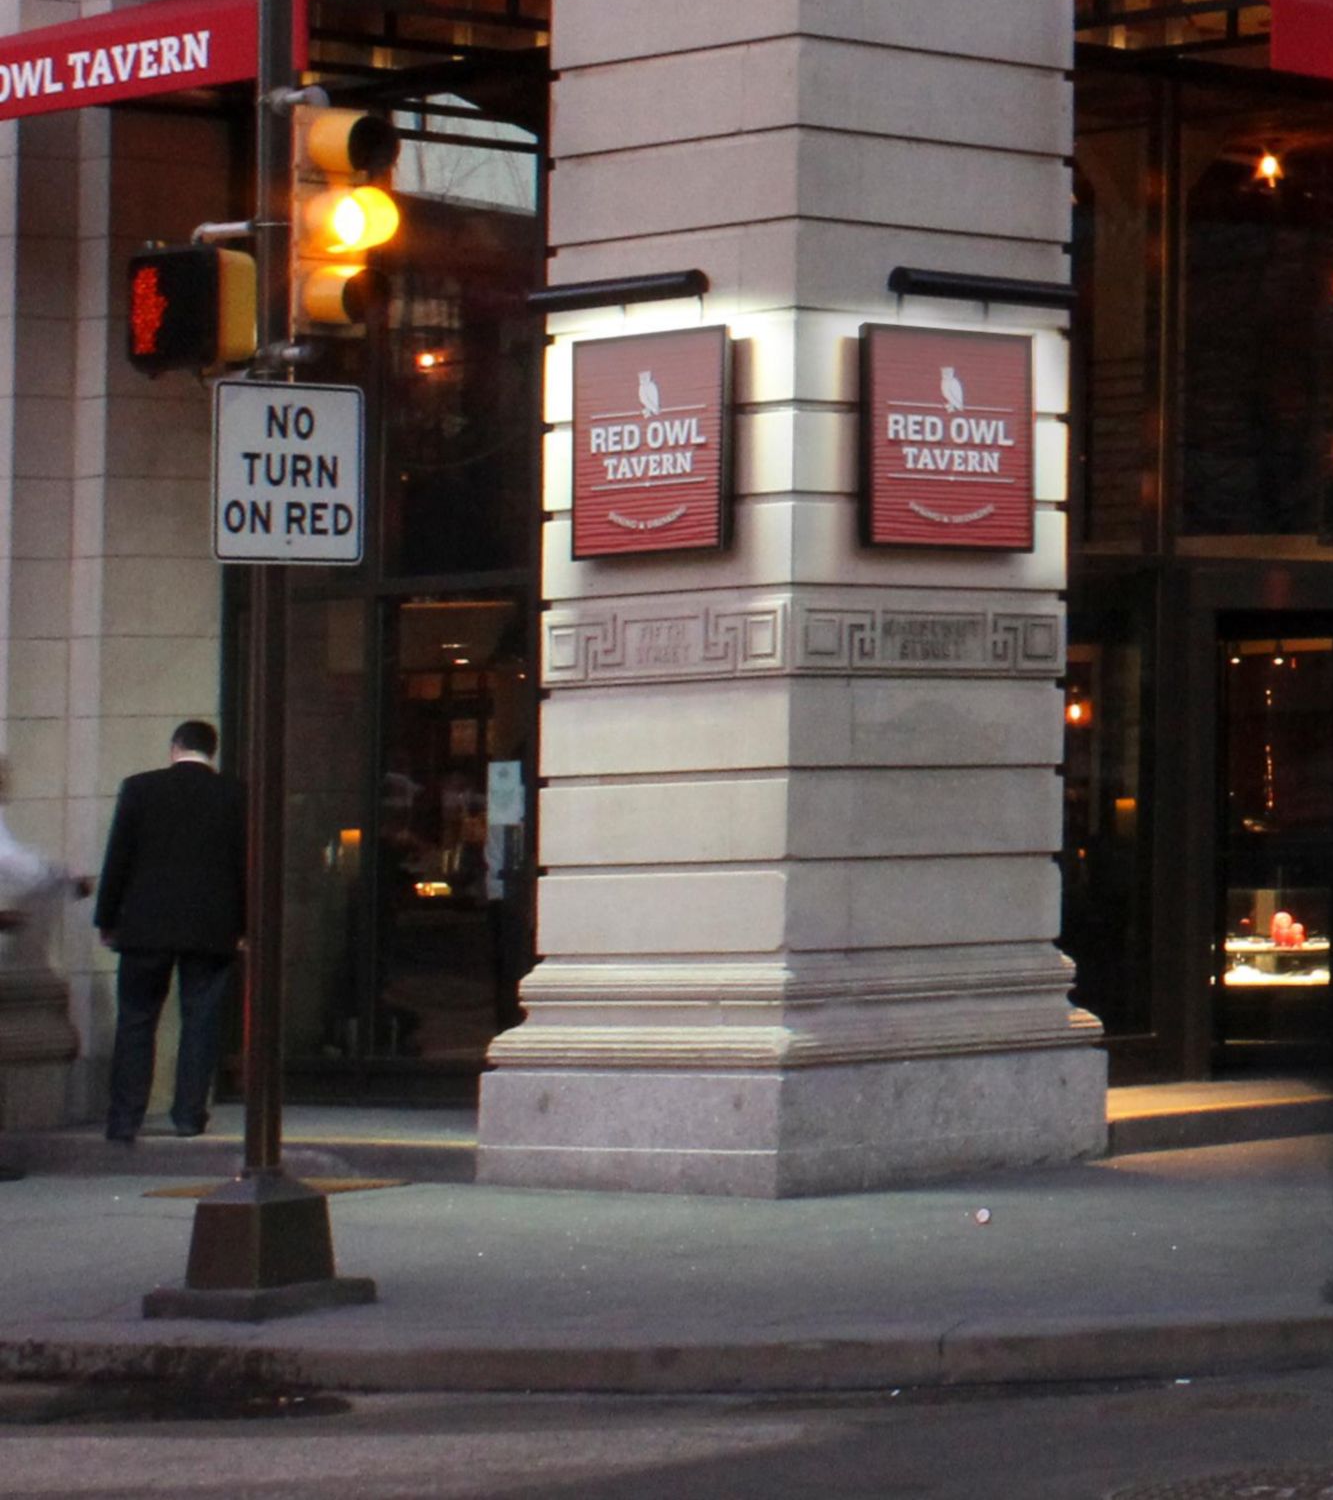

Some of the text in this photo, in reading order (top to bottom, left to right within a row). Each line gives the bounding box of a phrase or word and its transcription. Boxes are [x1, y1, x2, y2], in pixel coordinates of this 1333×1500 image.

[67, 30, 210, 90] TAVERN
[266, 405, 315, 440] NO
[590, 417, 707, 454] RED OWL
[888, 413, 1016, 446] RED OWL
[242, 452, 339, 488] TURN
[603, 450, 693, 480] TAVERN
[902, 446, 1000, 474] TAVERN
[223, 499, 354, 536] ON RED
